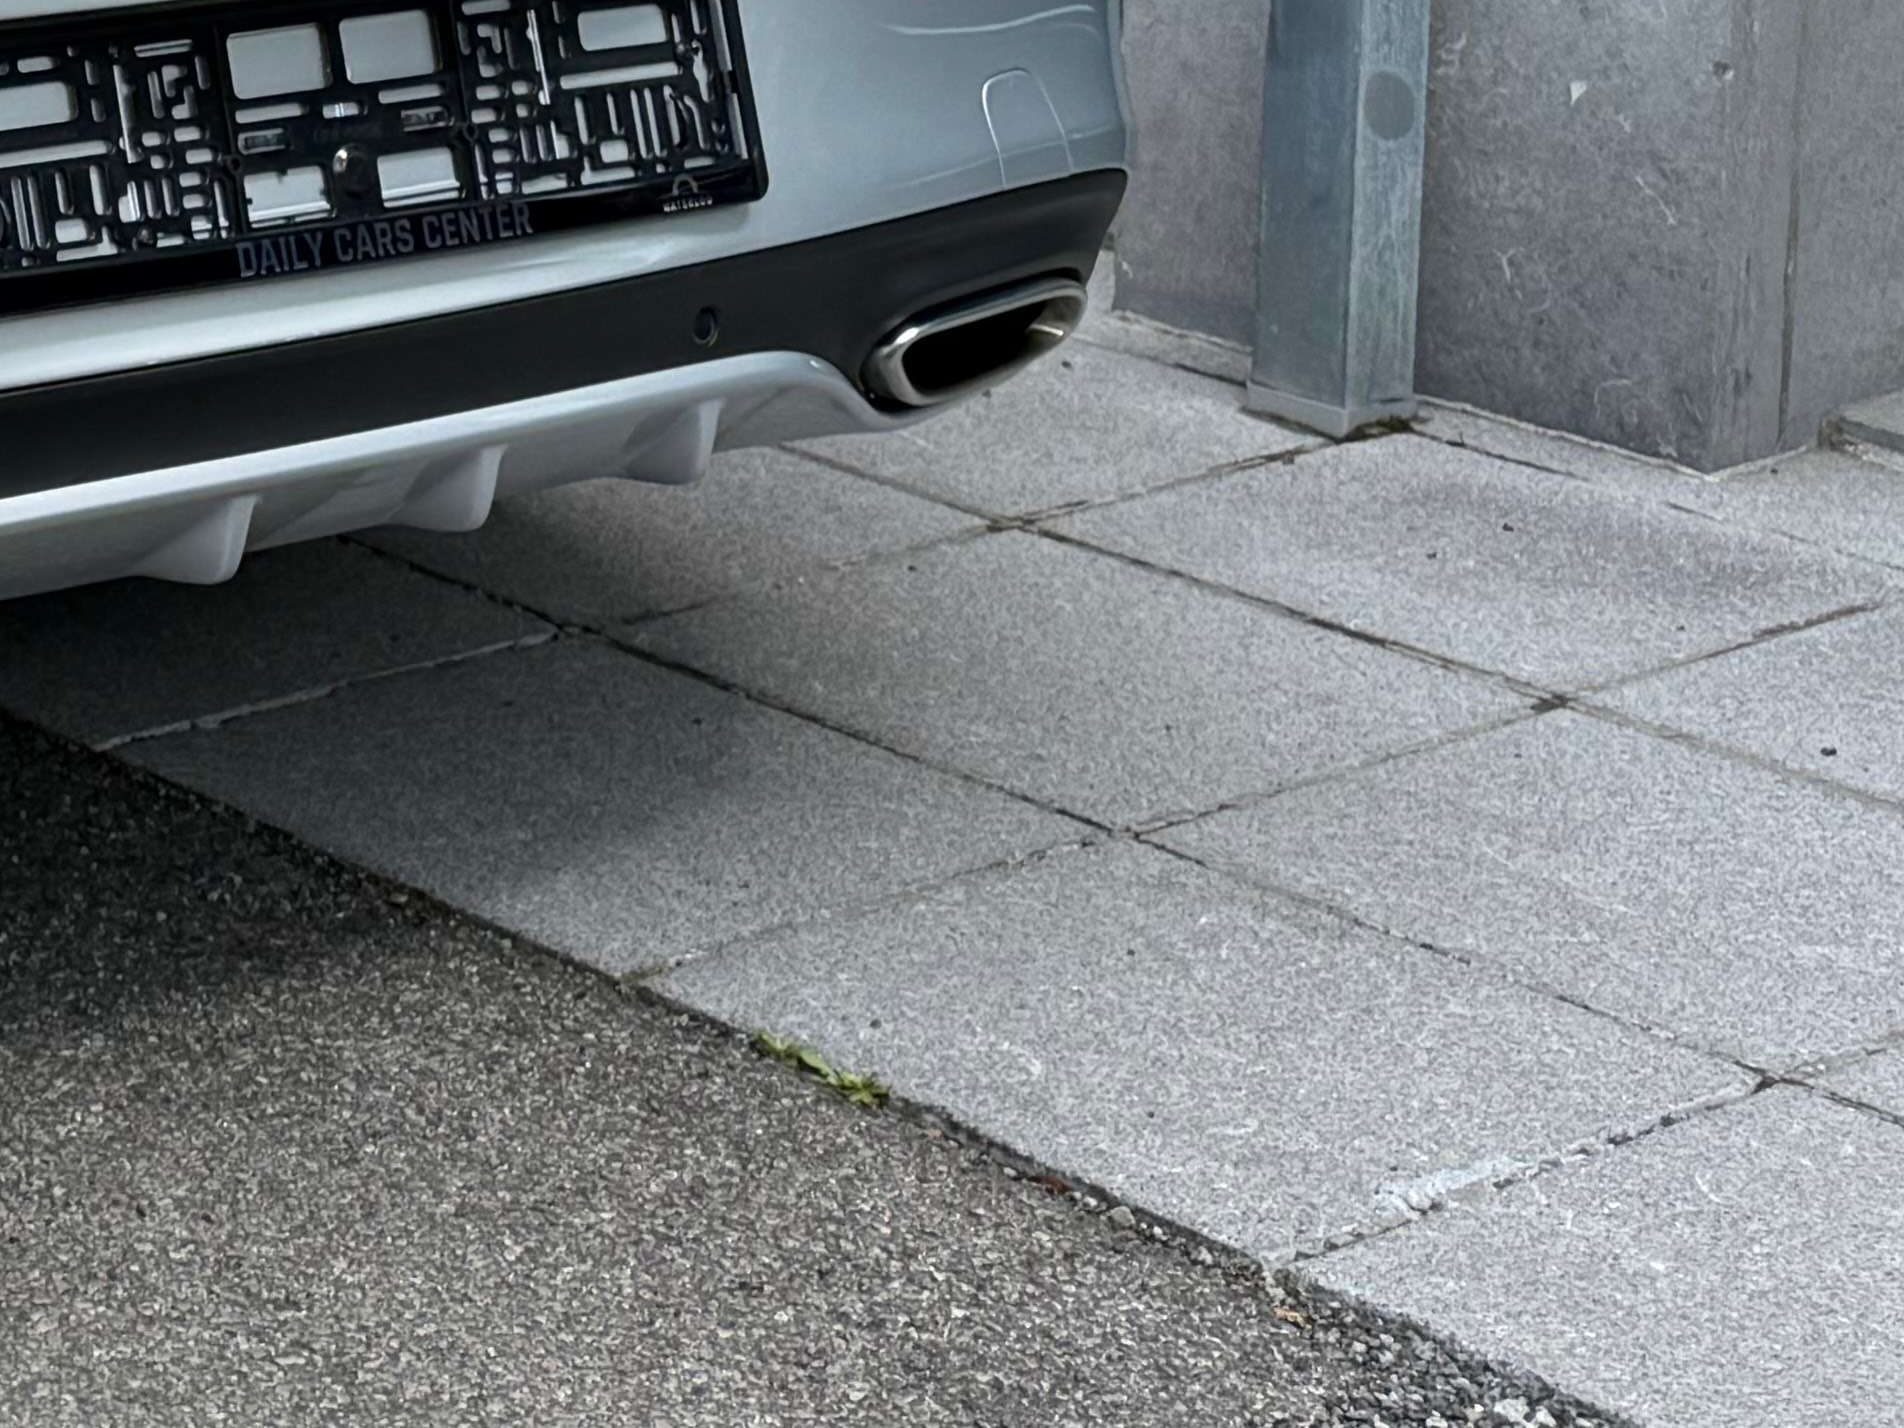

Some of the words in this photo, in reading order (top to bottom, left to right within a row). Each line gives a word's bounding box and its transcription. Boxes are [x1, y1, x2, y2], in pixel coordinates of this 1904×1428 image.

[235, 231, 324, 279] DAILY
[335, 222, 416, 263] CARS
[423, 200, 535, 250] CENTER
